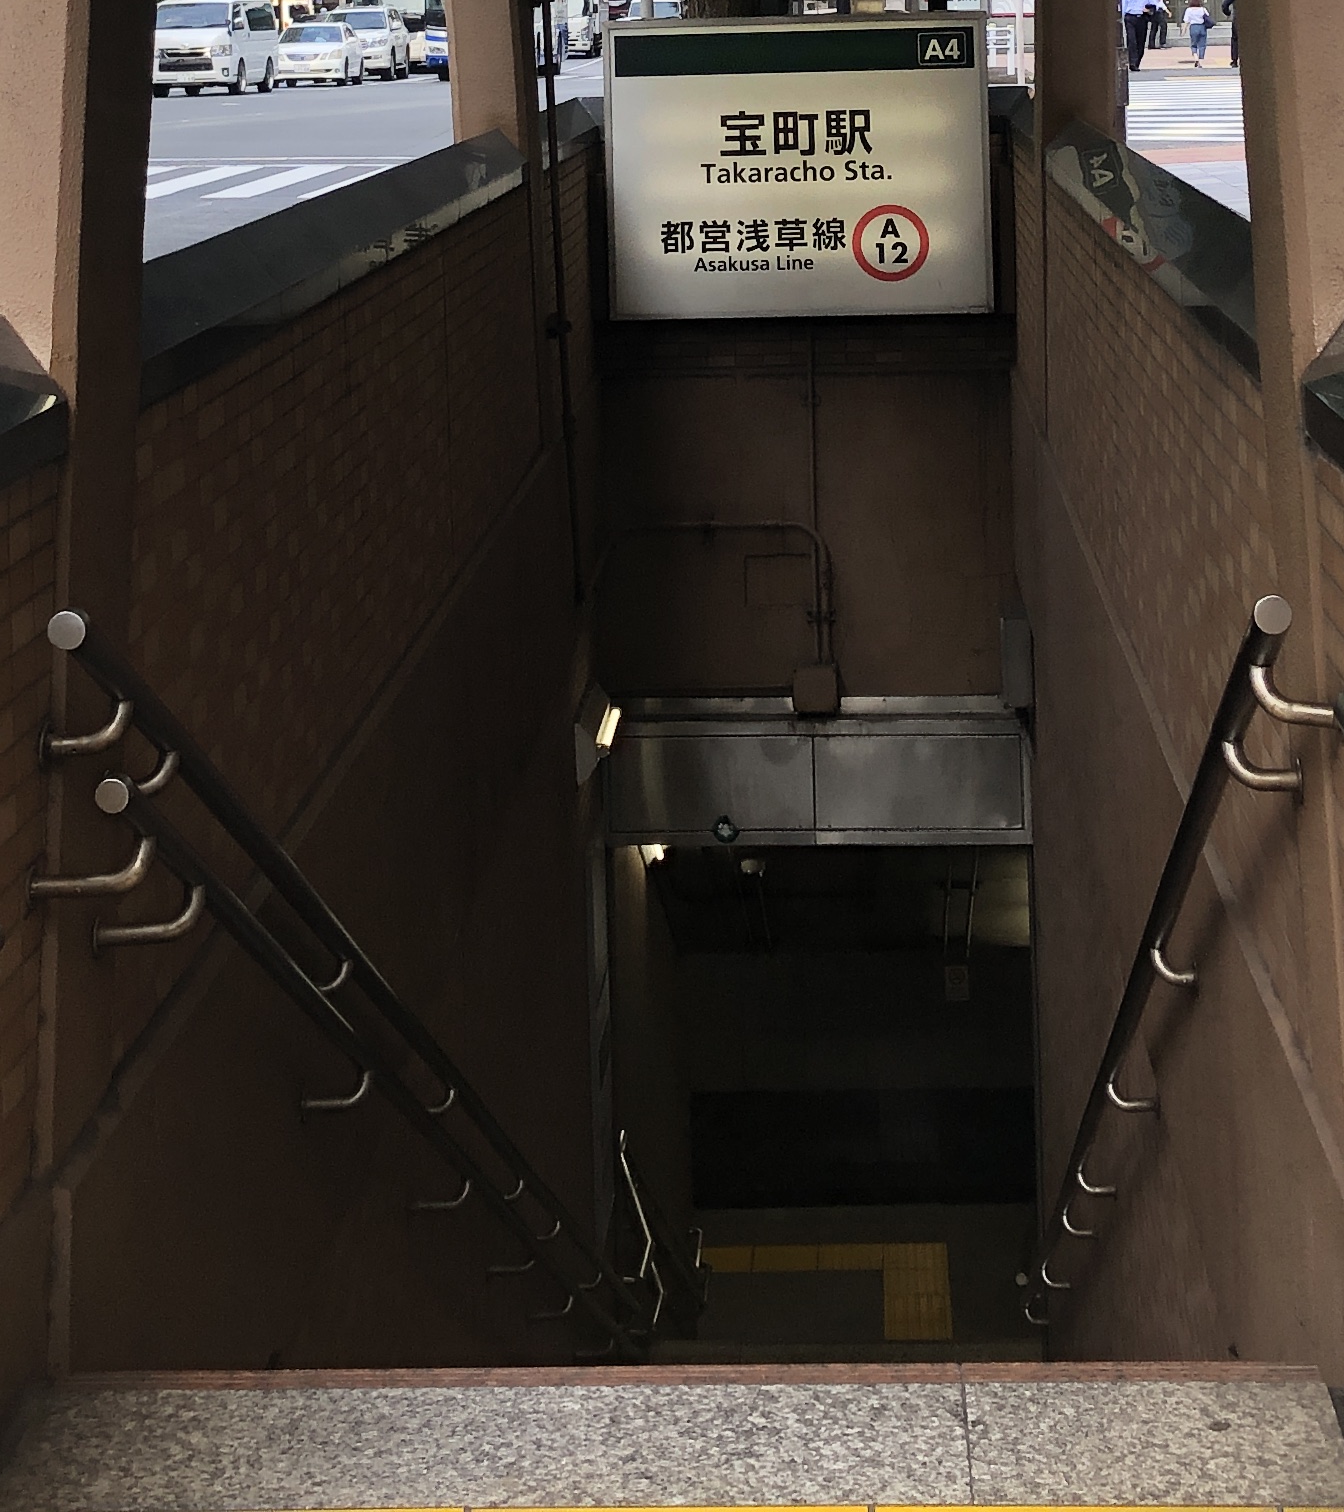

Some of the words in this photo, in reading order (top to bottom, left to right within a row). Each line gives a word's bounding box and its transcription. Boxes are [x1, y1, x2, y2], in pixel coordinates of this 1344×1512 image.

[924, 38, 960, 61] A4
[719, 109, 873, 157] 宝町駅
[700, 160, 836, 184] Takaracho
[844, 160, 893, 182] Sta.
[660, 217, 847, 255] 都営浅草線
[880, 218, 901, 239] A
[694, 256, 770, 272] Asakusa
[777, 255, 814, 271] Line
[875, 242, 909, 264] 12
